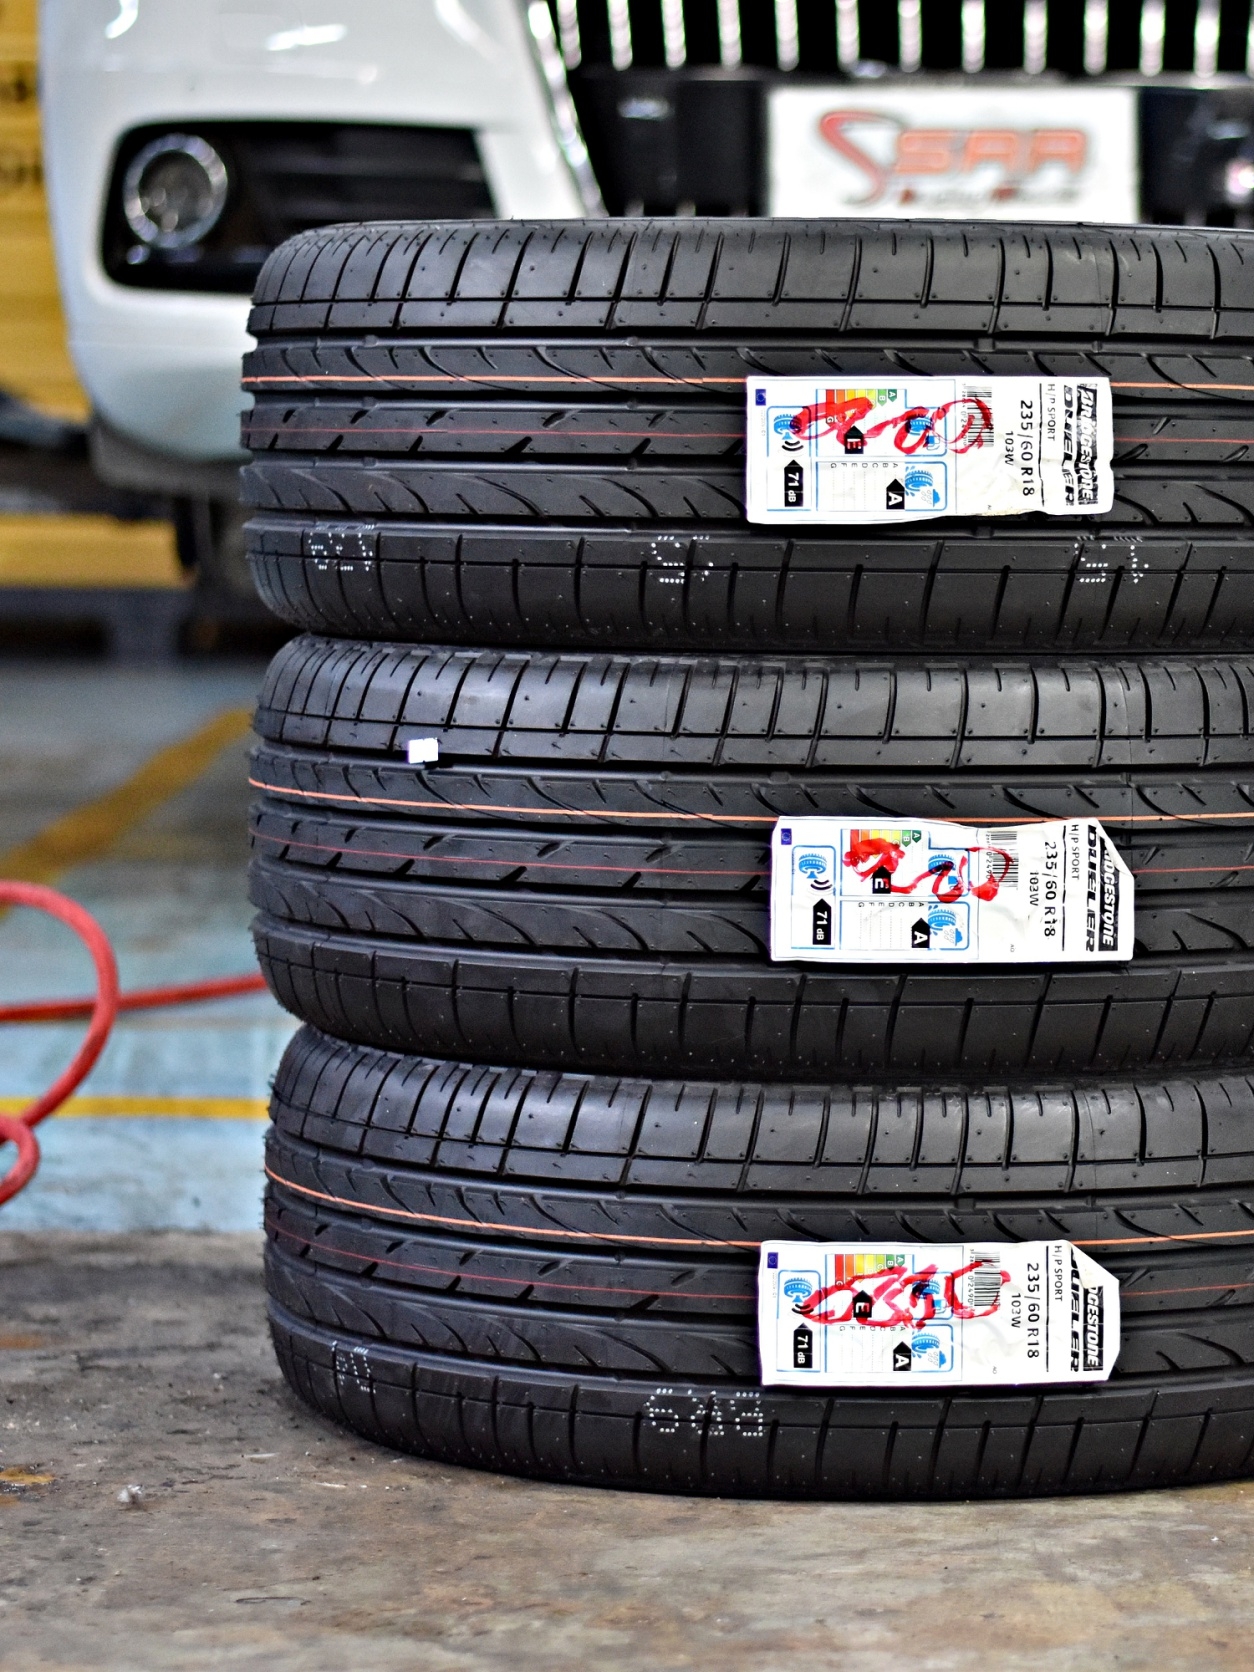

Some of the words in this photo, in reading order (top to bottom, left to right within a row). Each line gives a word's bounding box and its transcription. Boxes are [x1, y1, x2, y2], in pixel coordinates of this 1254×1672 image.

[1017, 400, 1034, 462] 235/60
[1047, 407, 1056, 441] SPORT
[1004, 430, 1015, 466] 103W
[787, 472, 799, 487] 71
[1020, 467, 1036, 496] R18
[788, 489, 797, 503] dB
[888, 491, 903, 506] A
[1042, 841, 1058, 900] 235/60
[1071, 846, 1080, 881] SPORT
[1029, 871, 1040, 907] 103W
[816, 910, 828, 926] 71
[1043, 906, 1057, 937] R18
[816, 927, 825, 942] dB
[913, 930, 929, 945] A
[1024, 1262, 1041, 1323] 235/60
[1055, 1268, 1063, 1302] SPORT
[1011, 1292, 1022, 1329] 103W
[797, 1335, 809, 1349] 71
[1026, 1328, 1040, 1358] R18
[797, 1351, 806, 1364] dB
[895, 1353, 910, 1368] A
